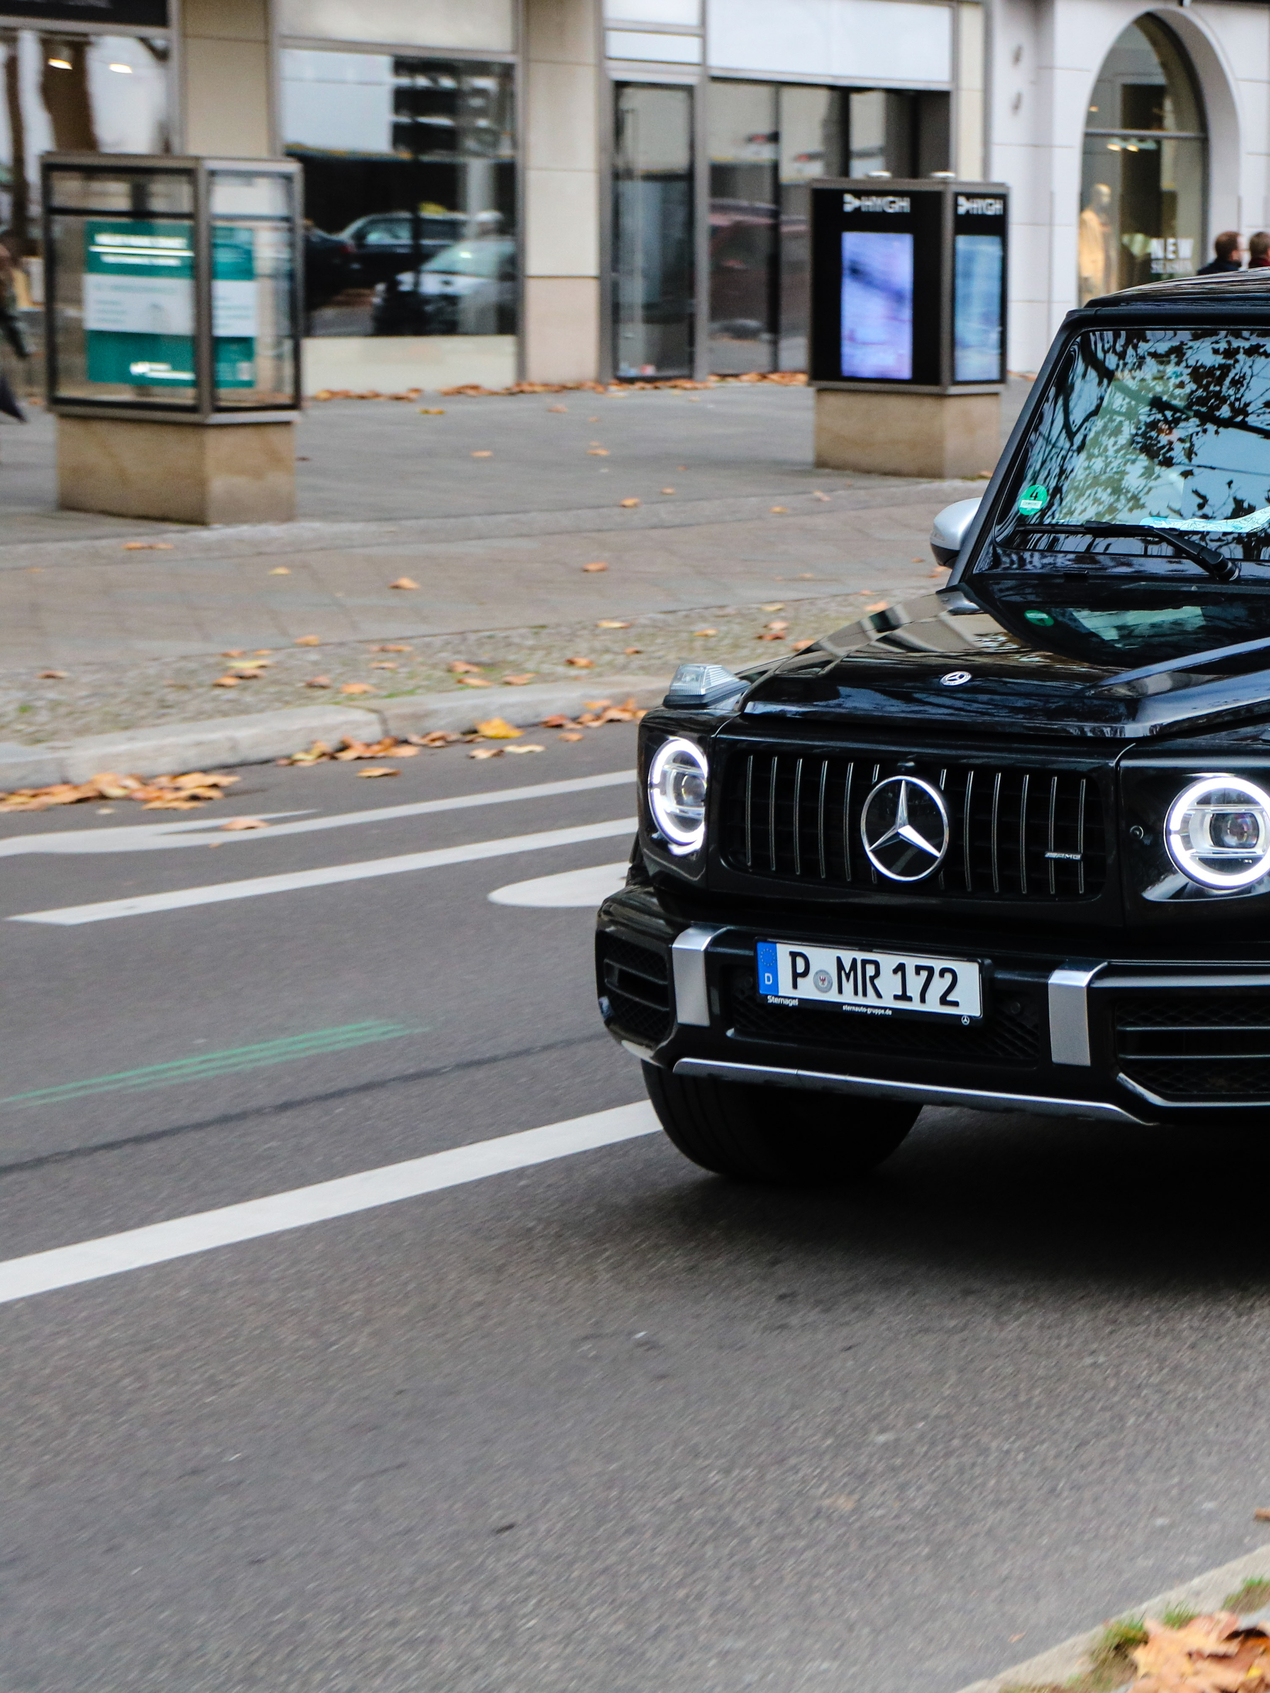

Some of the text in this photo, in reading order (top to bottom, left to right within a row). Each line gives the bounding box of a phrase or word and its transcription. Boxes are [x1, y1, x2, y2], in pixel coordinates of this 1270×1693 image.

[1151, 238, 1194, 260] NEW
[1029, 485, 1040, 501] 4
[764, 973, 773, 985] D
[788, 950, 960, 1007] P MR 172
[767, 995, 799, 1007] Sternagel
[842, 1004, 892, 1016] sternauto-gruppe.de
